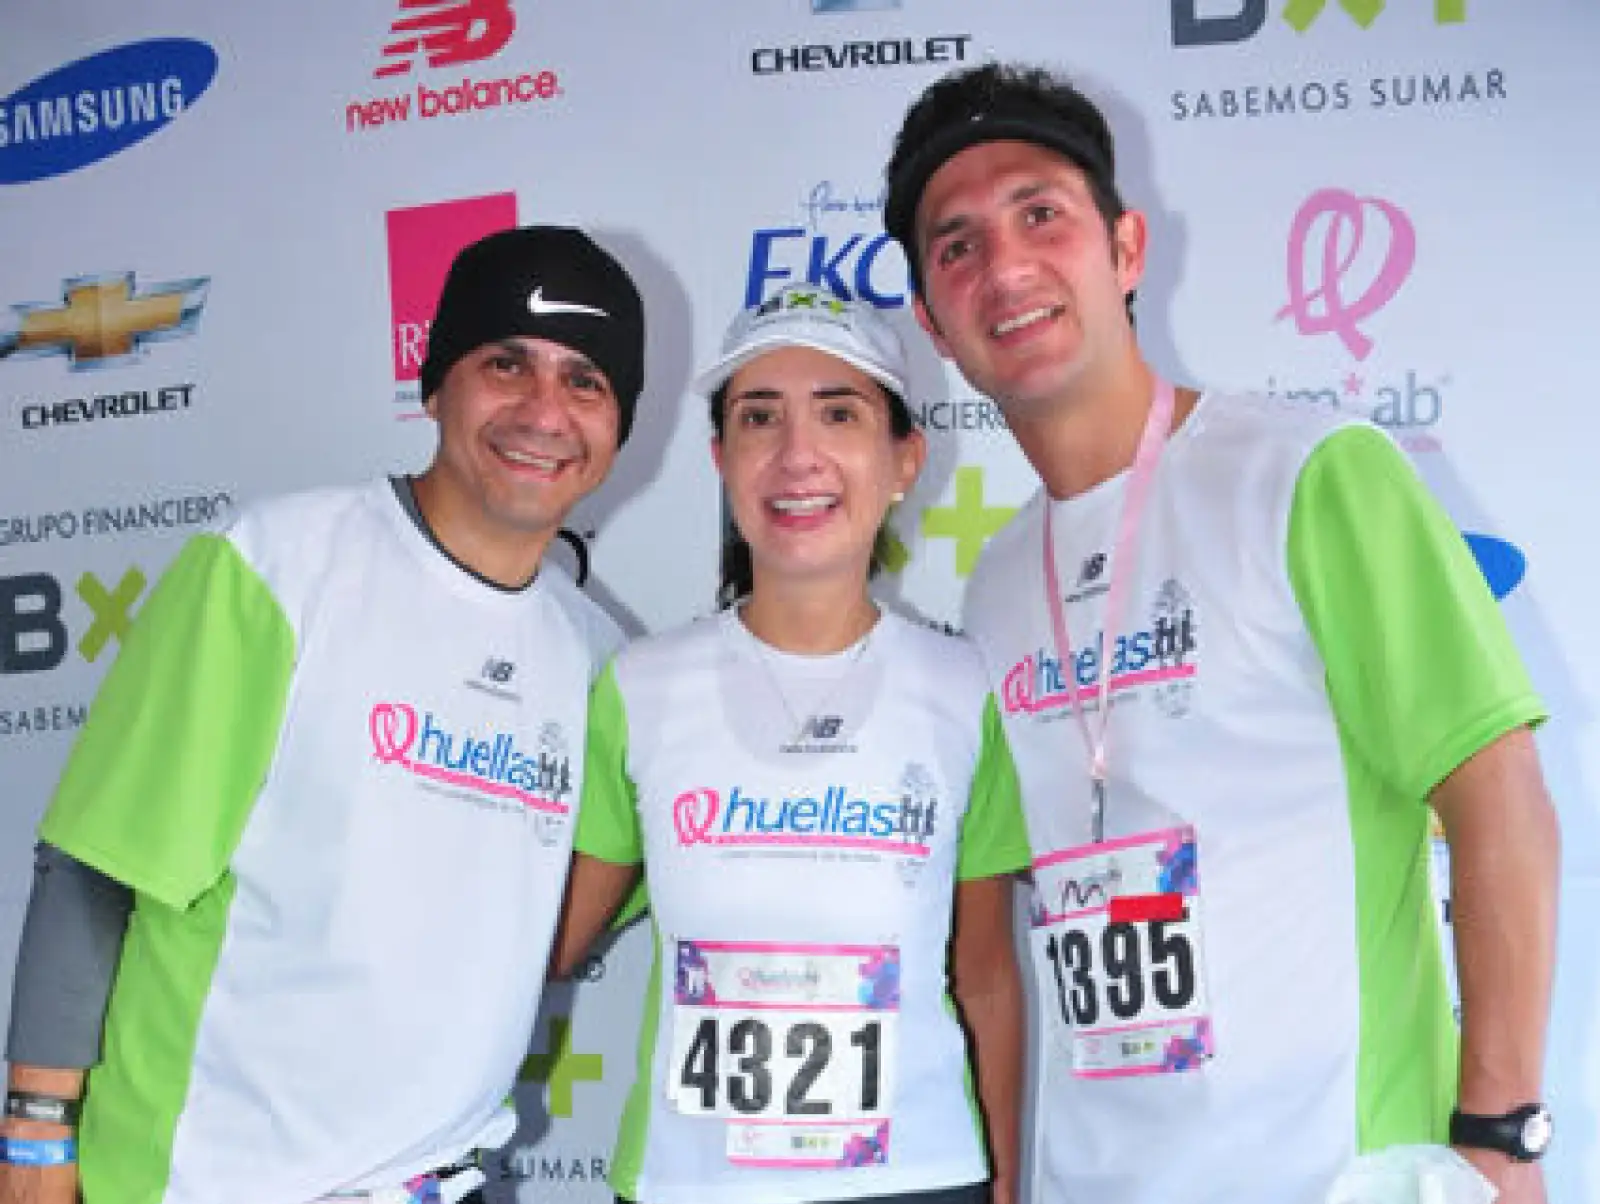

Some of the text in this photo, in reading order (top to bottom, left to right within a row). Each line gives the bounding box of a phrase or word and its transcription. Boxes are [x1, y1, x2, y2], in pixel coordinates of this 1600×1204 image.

[752, 34, 972, 75] CHEVROLET
[346, 94, 411, 133] new
[1171, 69, 1508, 121] SABEMOS SUMAR
[22, 383, 196, 429] CHEVROLET
[722, 786, 893, 837] huellas
[1046, 921, 1195, 1026] 1395
[680, 1018, 883, 1115] 4321
